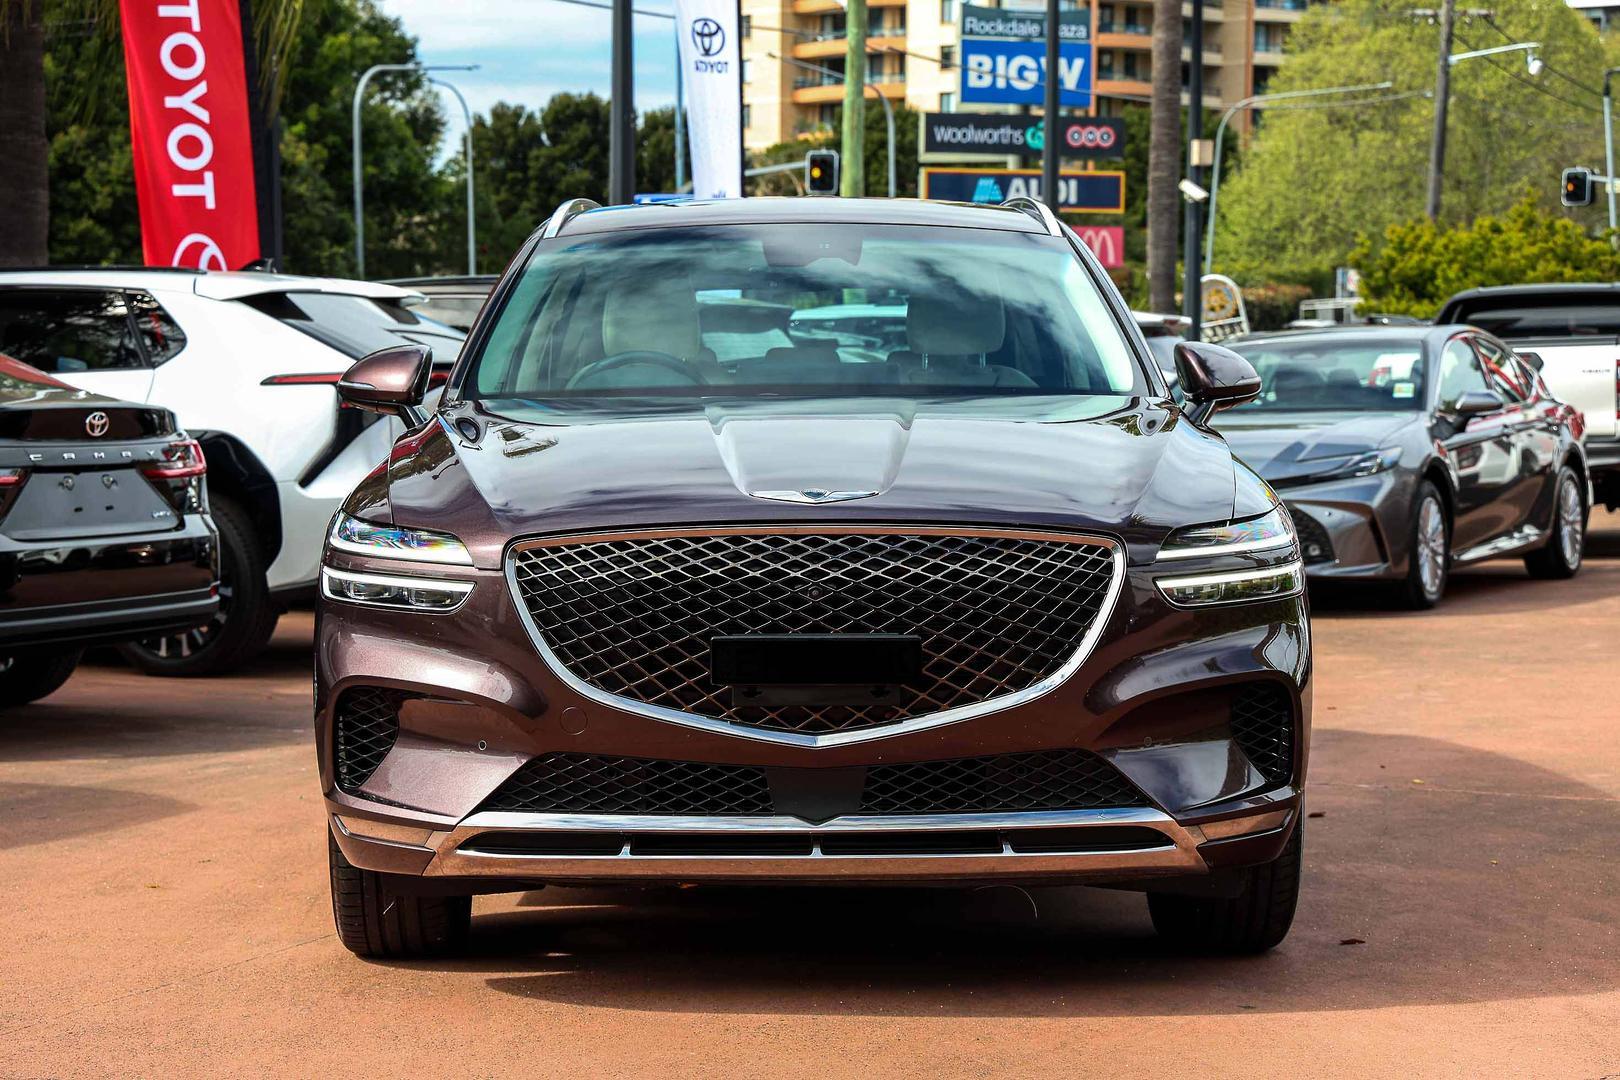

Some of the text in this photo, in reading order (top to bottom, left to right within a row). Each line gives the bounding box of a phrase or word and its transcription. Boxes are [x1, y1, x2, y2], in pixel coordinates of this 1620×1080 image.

[964, 16, 1088, 39] Rockdale aza
[933, 123, 1024, 146] Woolworths
